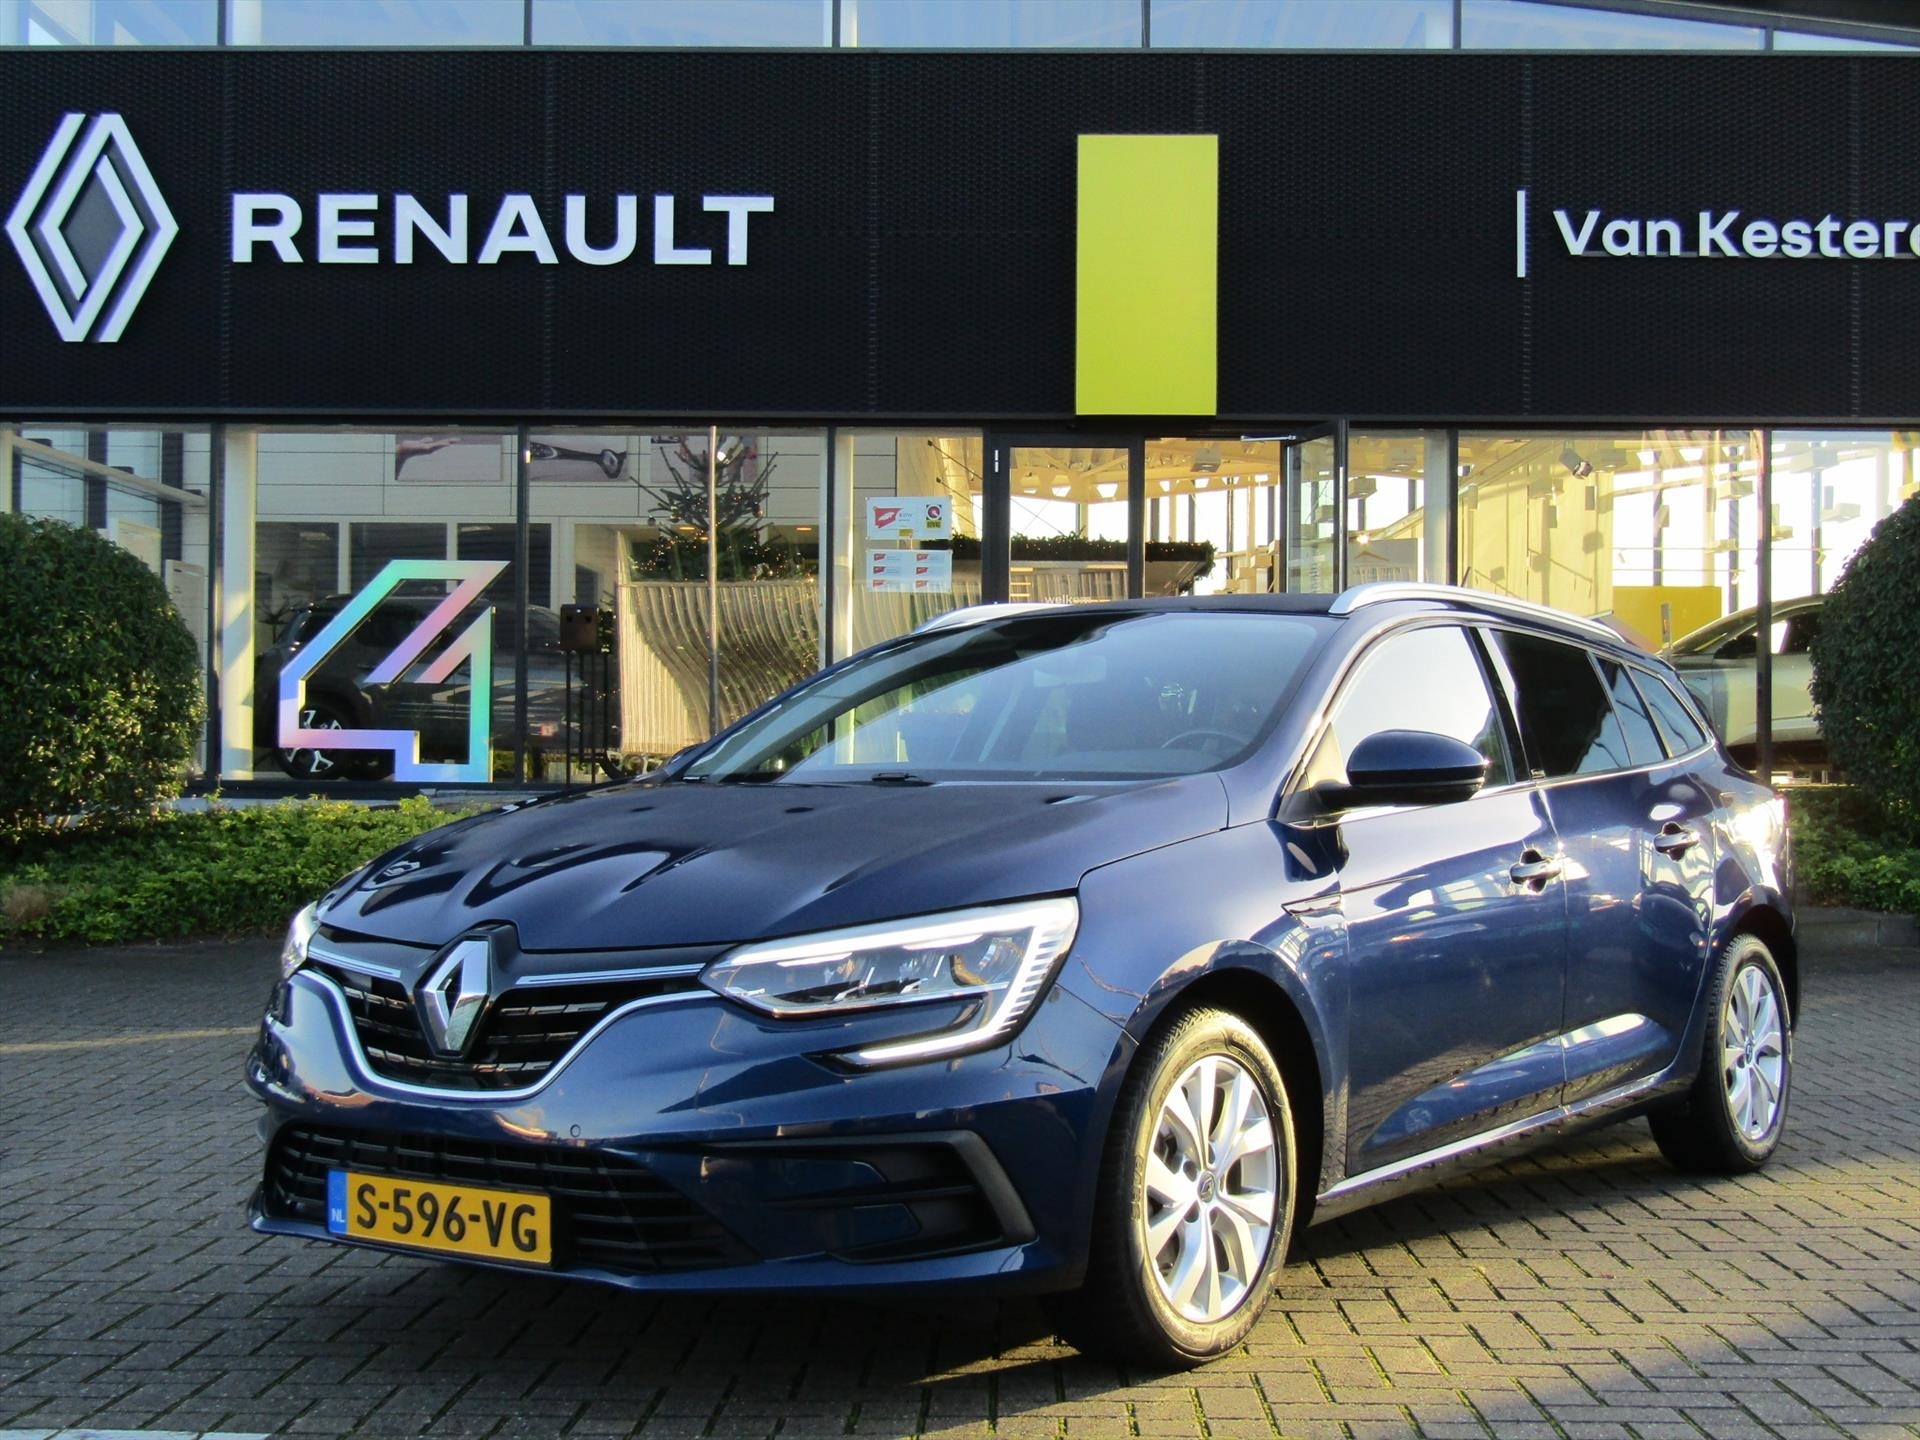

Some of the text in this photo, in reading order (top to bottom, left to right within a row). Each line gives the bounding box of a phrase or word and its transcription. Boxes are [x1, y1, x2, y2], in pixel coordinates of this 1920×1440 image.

[231, 194, 775, 266] RENAULT
[1552, 210, 1681, 257] Van
[331, 1207, 345, 1223] NL
[356, 1183, 537, 1252] S-596-VG
